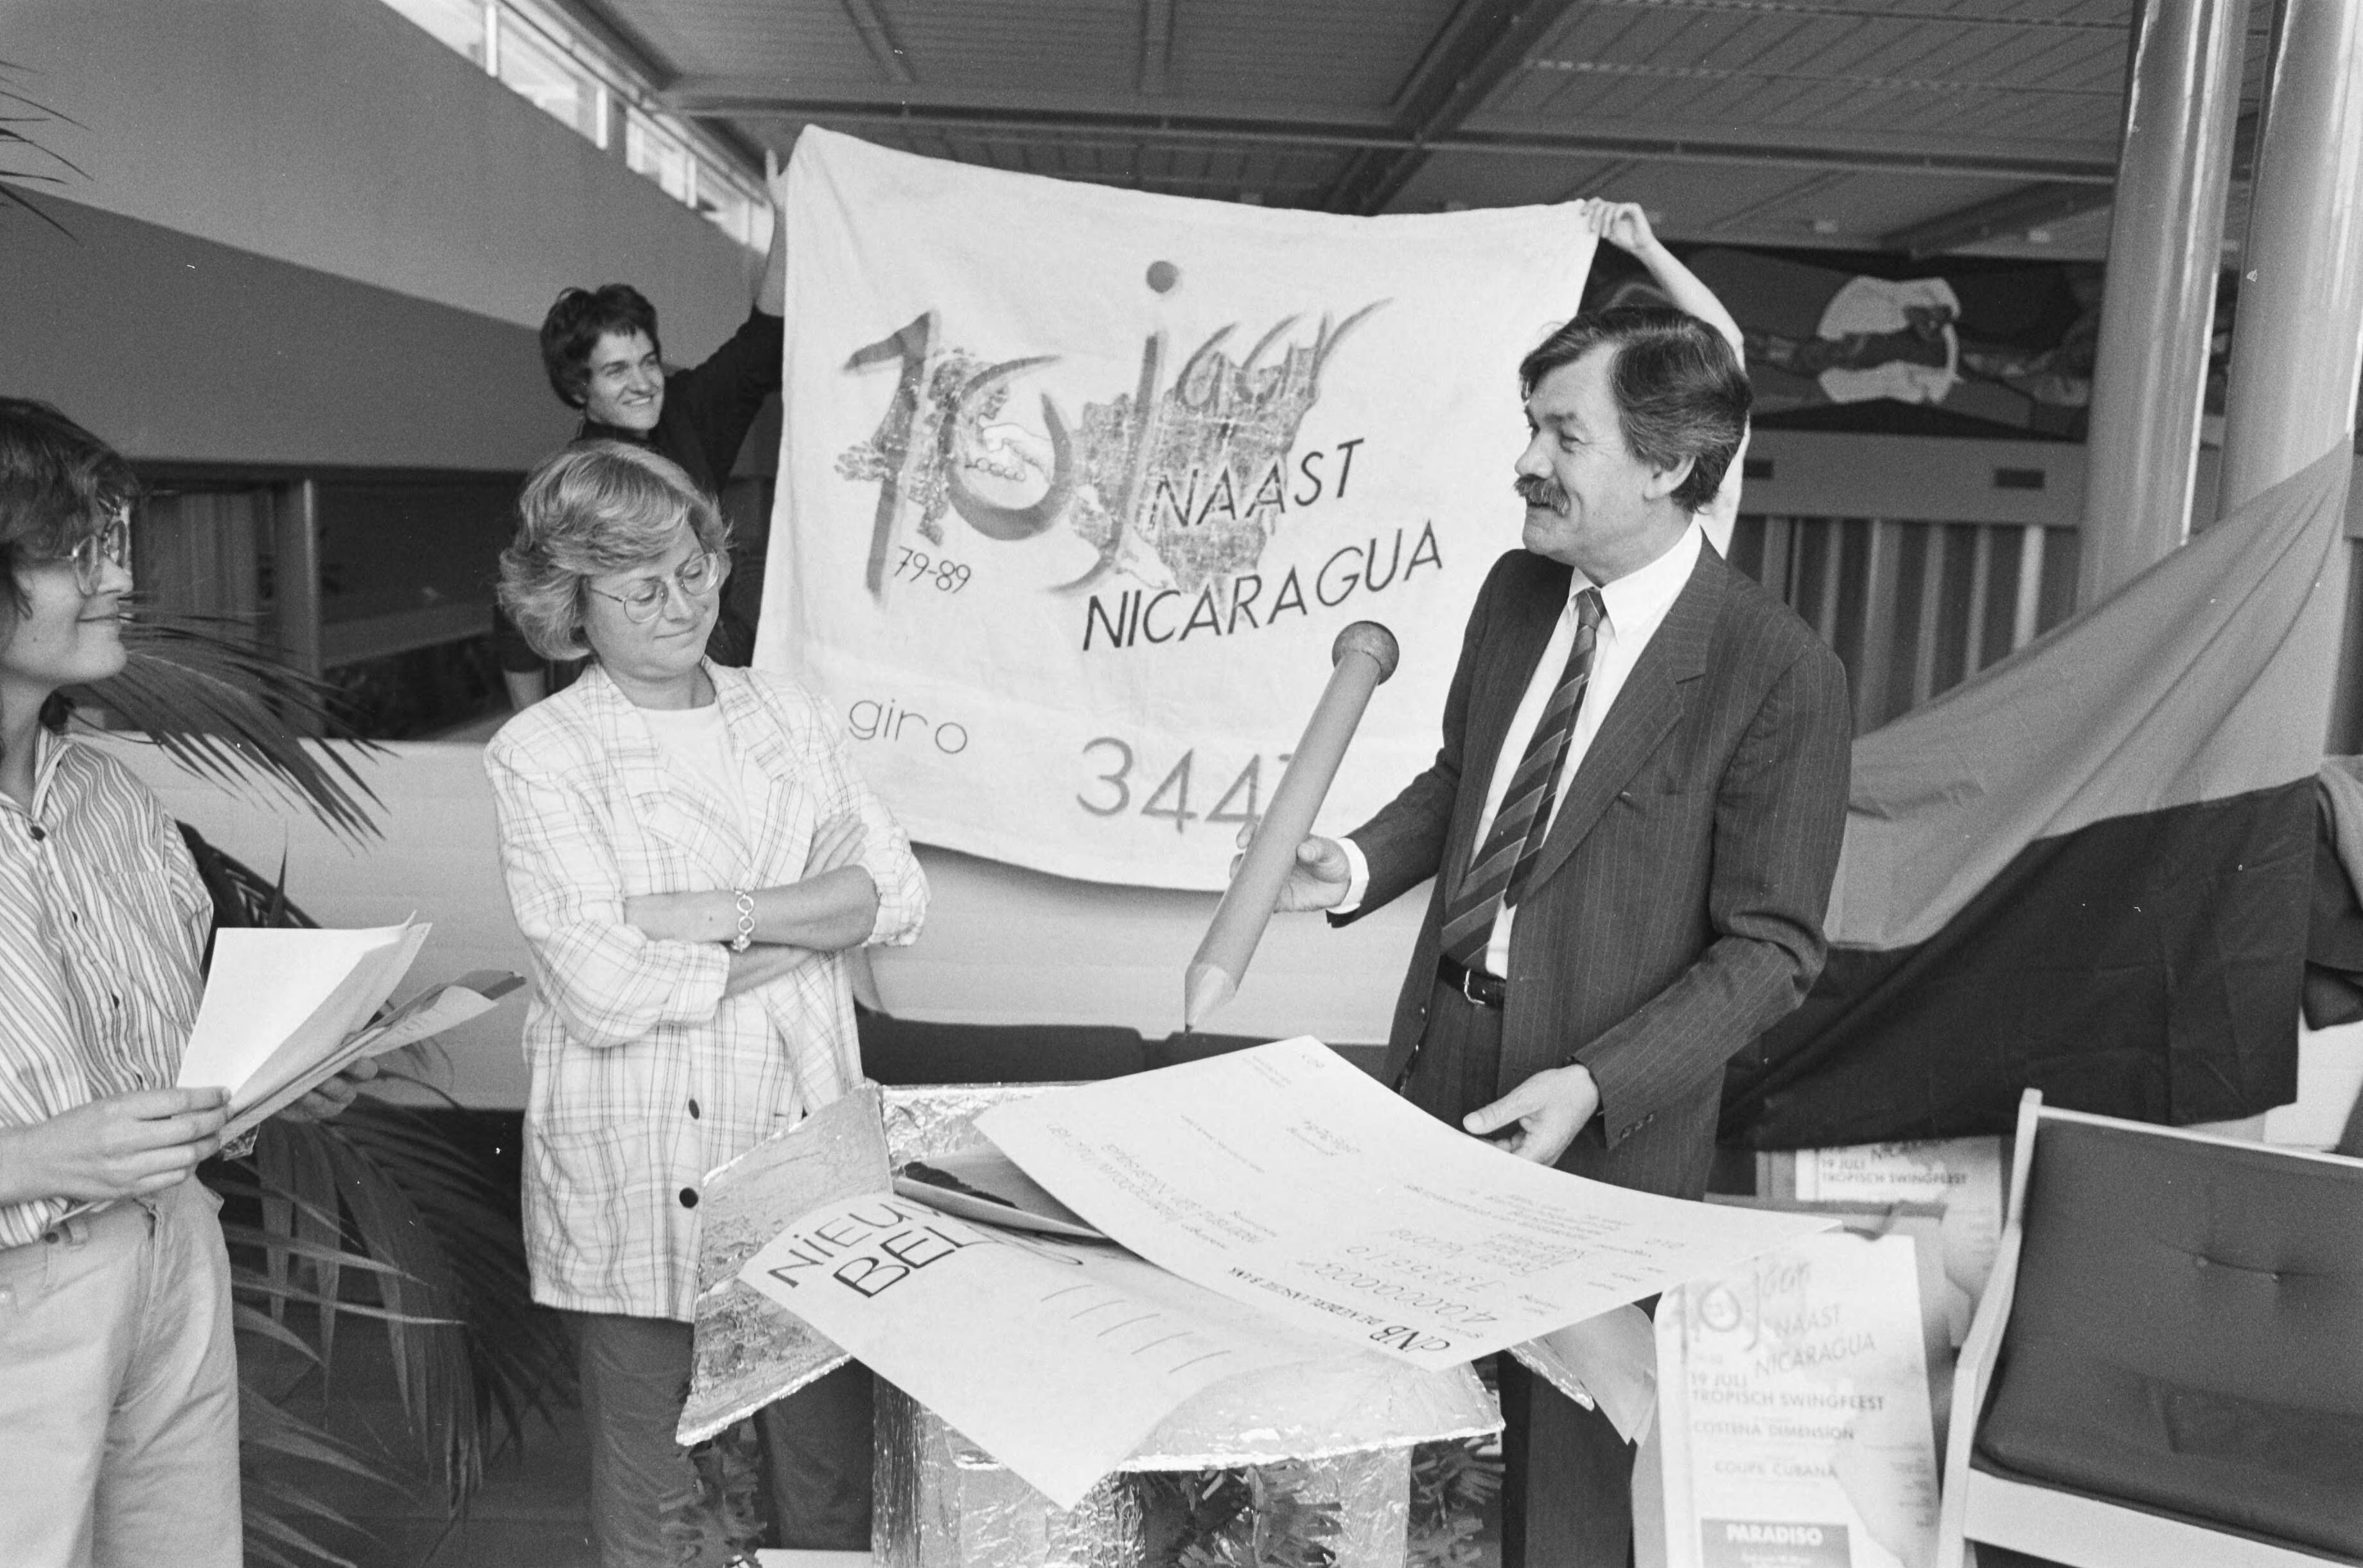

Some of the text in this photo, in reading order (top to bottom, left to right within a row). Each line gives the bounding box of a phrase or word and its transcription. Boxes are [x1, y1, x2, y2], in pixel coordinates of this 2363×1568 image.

[1148, 438, 1366, 528] NAAST
[893, 545, 971, 594] 79-89
[1082, 519, 1443, 651] NICARAGUA
[847, 697, 968, 755] giro
[1076, 736, 1295, 834] 344
[1775, 1303, 1841, 1339] NAAST
[1714, 1372, 1748, 1388] JULI
[1753, 1332, 1877, 1381] NICARAGUA
[1691, 1389, 1886, 1411] TROPISCH SWINGFEEST
[1725, 1524, 1825, 1547] PARADISO
